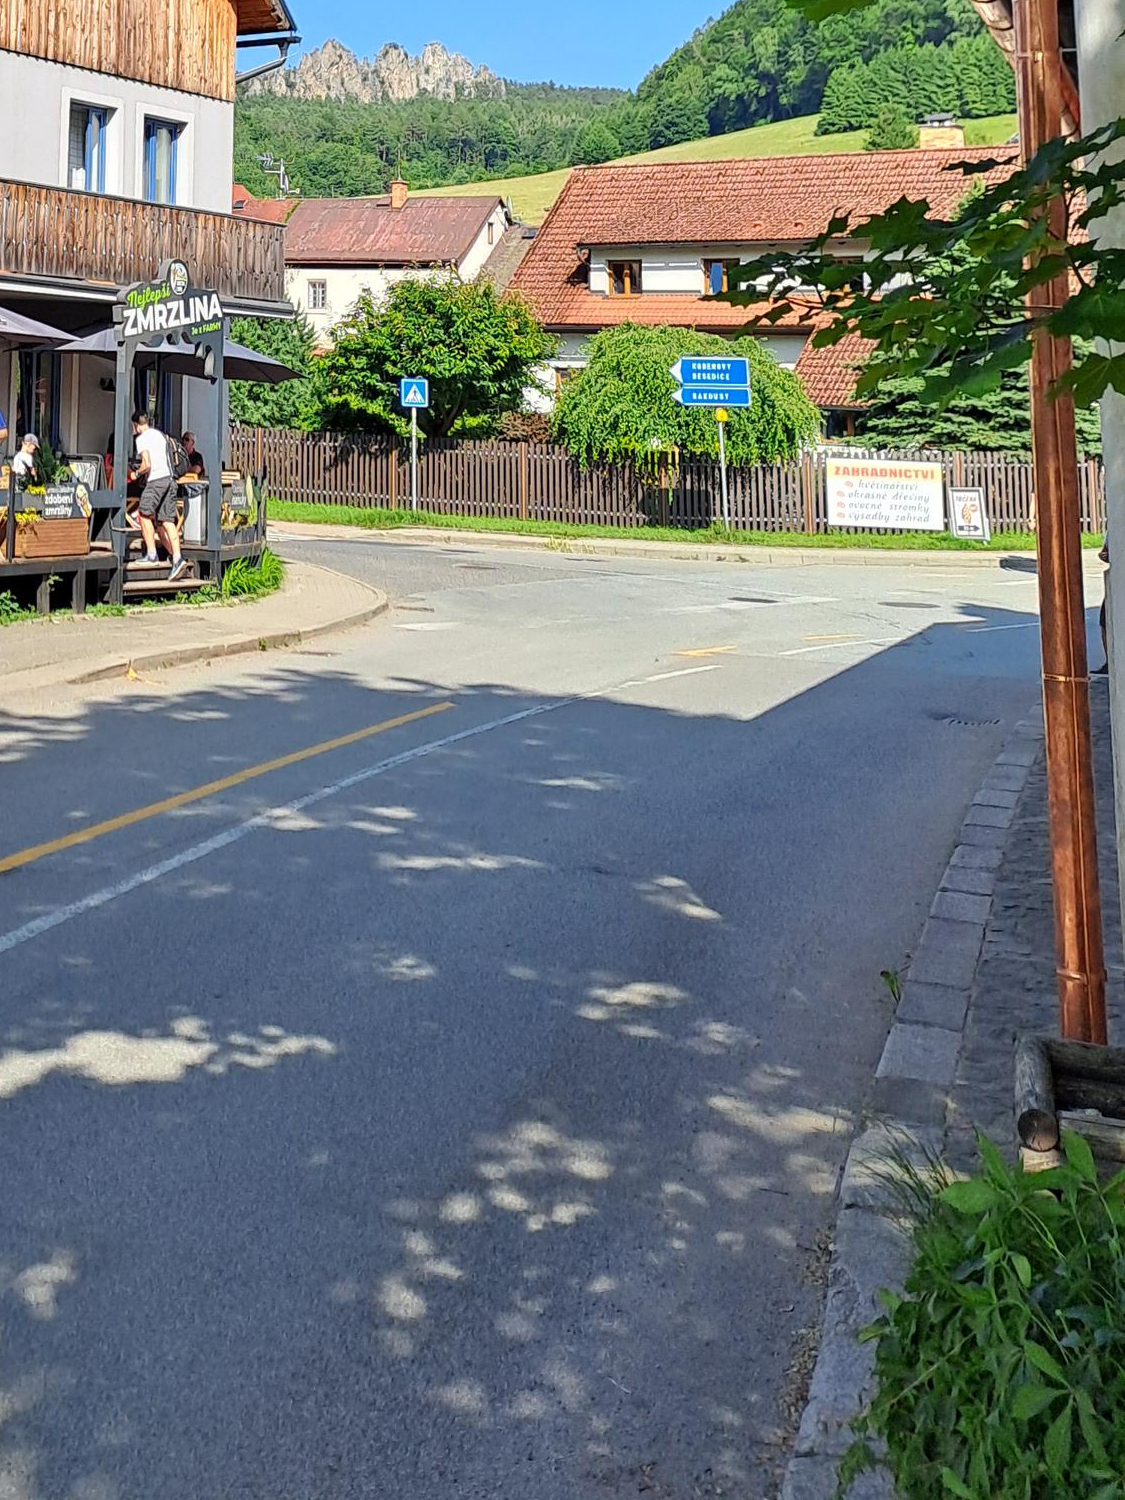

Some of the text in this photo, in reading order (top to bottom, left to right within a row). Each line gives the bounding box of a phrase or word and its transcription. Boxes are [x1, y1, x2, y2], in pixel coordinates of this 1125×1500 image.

[127, 282, 171, 309] Nejlepší
[123, 293, 223, 337] ZMRZLINA
[834, 466, 935, 480] ZAHRADNICTVÍ
[889, 503, 930, 514] stromky
[895, 513, 930, 523] zahrad
